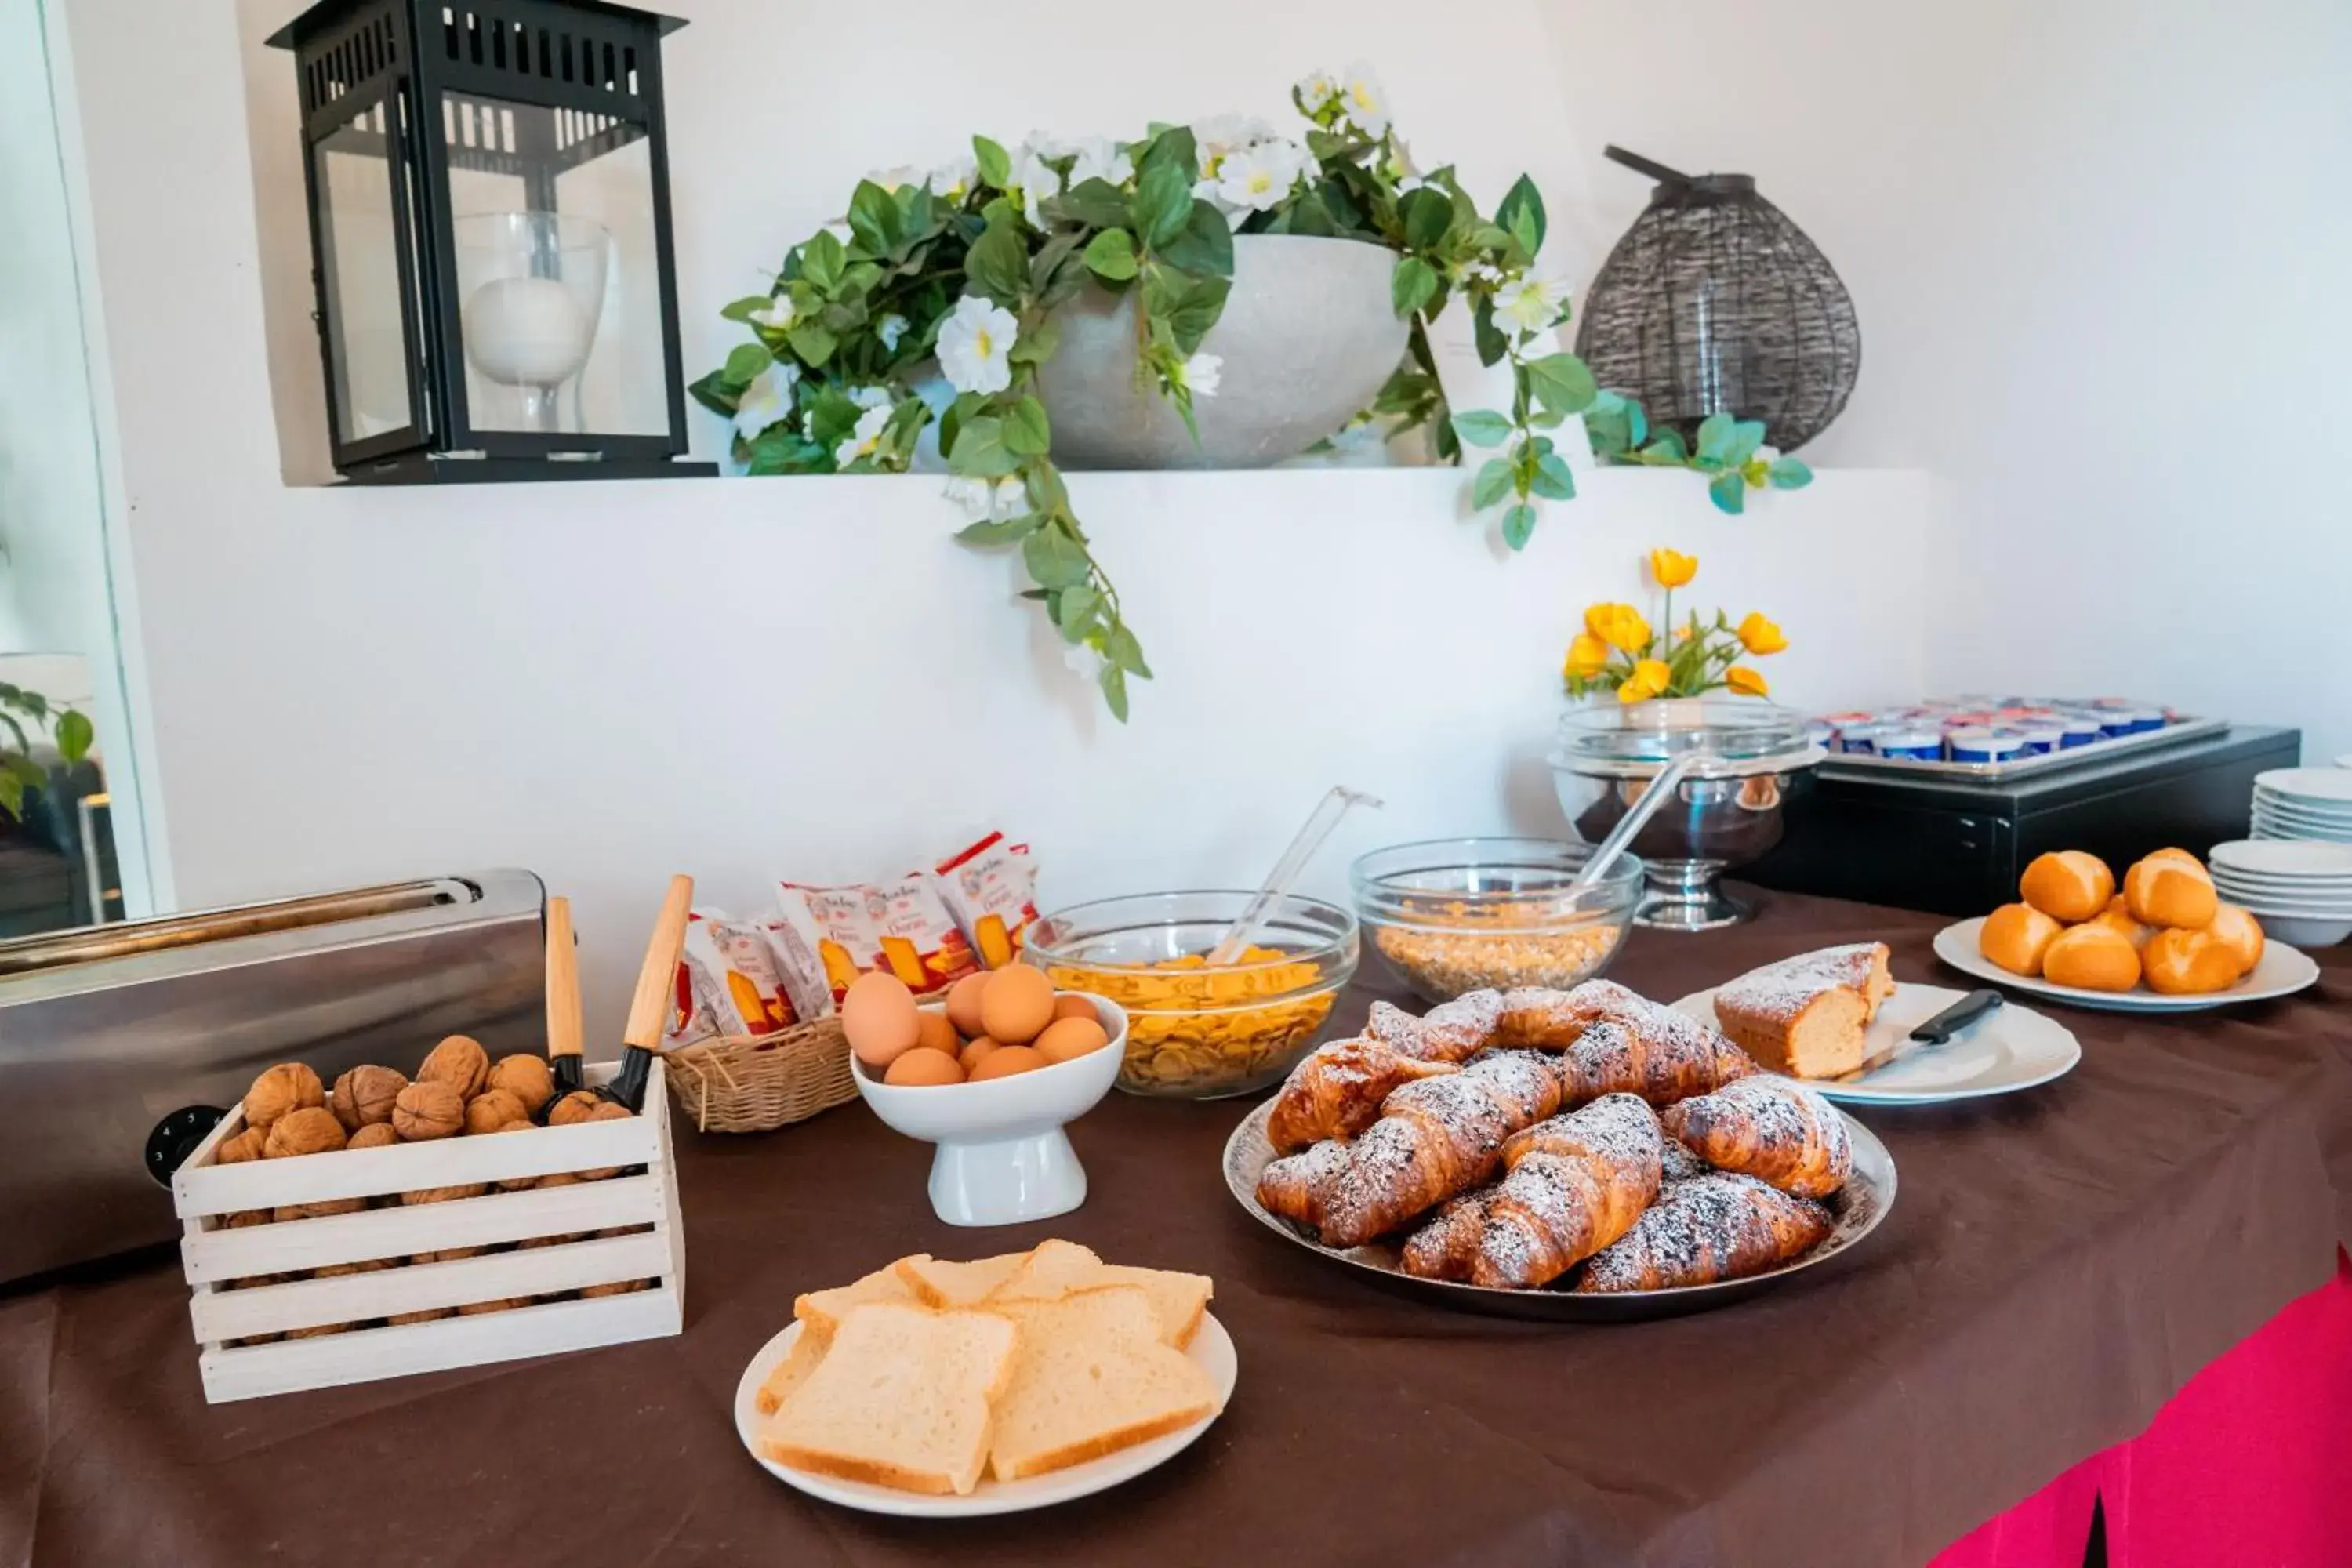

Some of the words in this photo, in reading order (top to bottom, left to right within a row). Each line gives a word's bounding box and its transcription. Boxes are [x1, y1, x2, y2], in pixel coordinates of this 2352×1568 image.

[188, 1113, 194, 1123] 5
[163, 1127, 170, 1136] 4
[156, 1152, 163, 1161] 3
